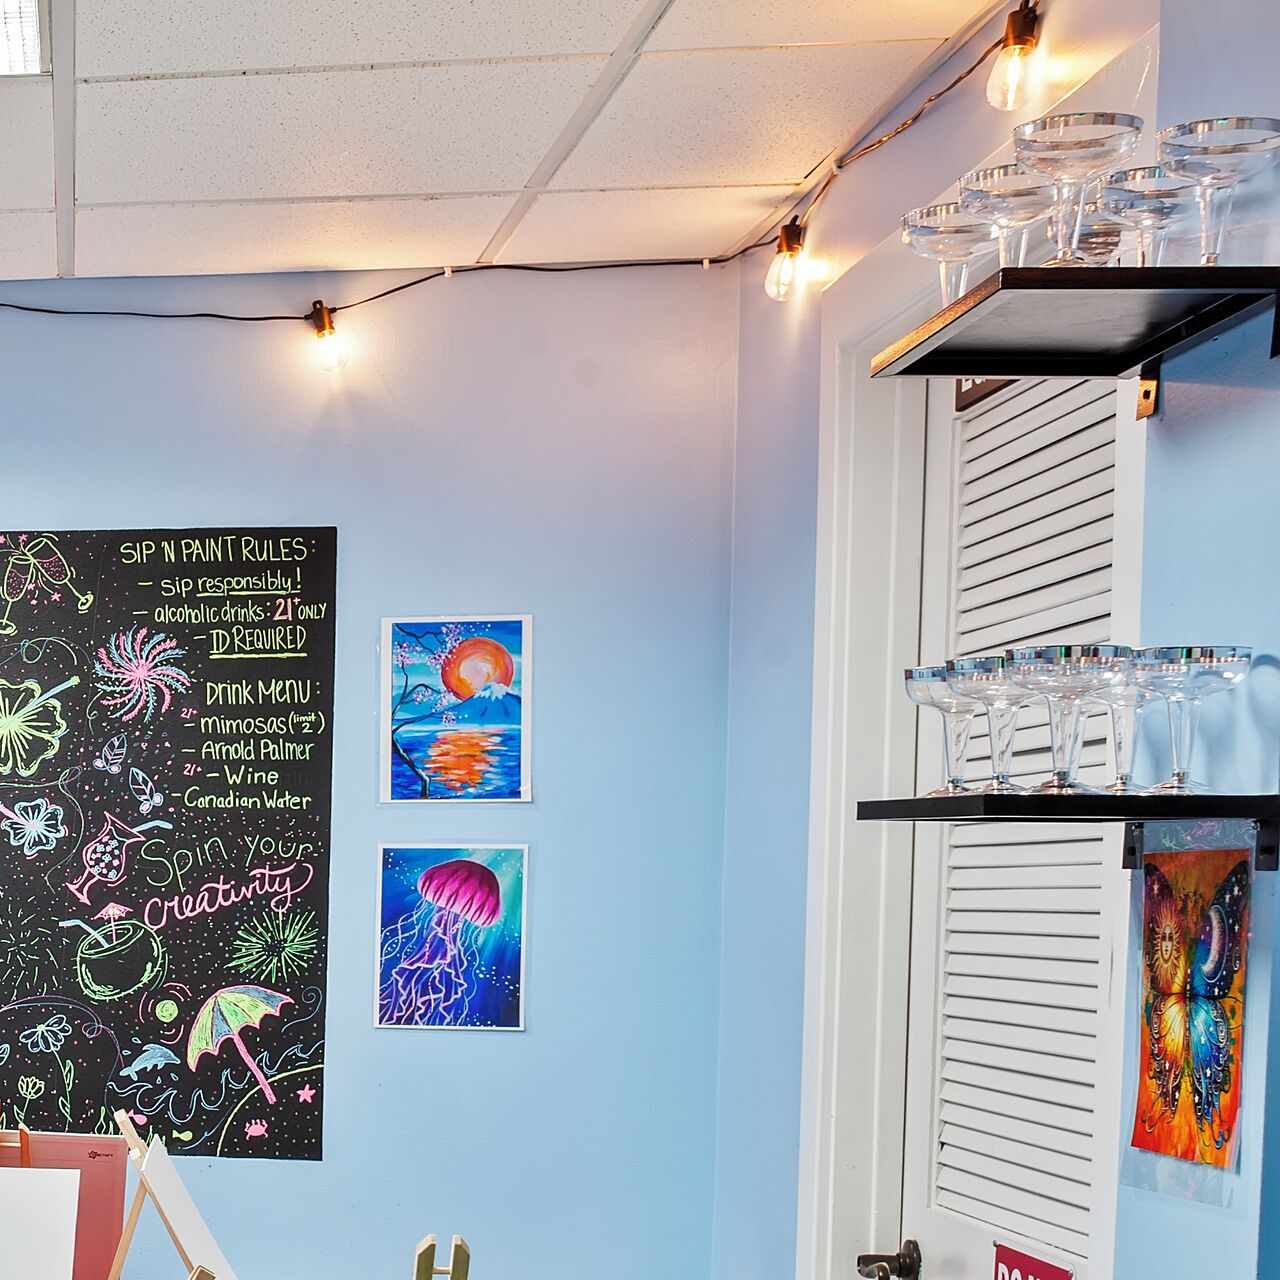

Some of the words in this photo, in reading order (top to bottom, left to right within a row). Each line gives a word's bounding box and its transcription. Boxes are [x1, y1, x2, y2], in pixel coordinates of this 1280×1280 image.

[120, 540, 156, 564] SIP
[181, 536, 236, 563] PAINT
[161, 576, 193, 598] sip
[154, 603, 219, 624] alcoholic
[298, 602, 327, 620] ONLY
[209, 629, 231, 654] ID
[232, 625, 307, 652] REQUIRED
[200, 715, 287, 735] mimosas
[201, 738, 255, 760] Arnold
[260, 738, 315, 760] Palmer
[223, 765, 279, 785] Wine
[184, 786, 261, 809] Canadian
[262, 789, 312, 810] Water
[140, 837, 229, 893] Spin
[244, 834, 314, 867] your
[143, 861, 314, 930] creativity
